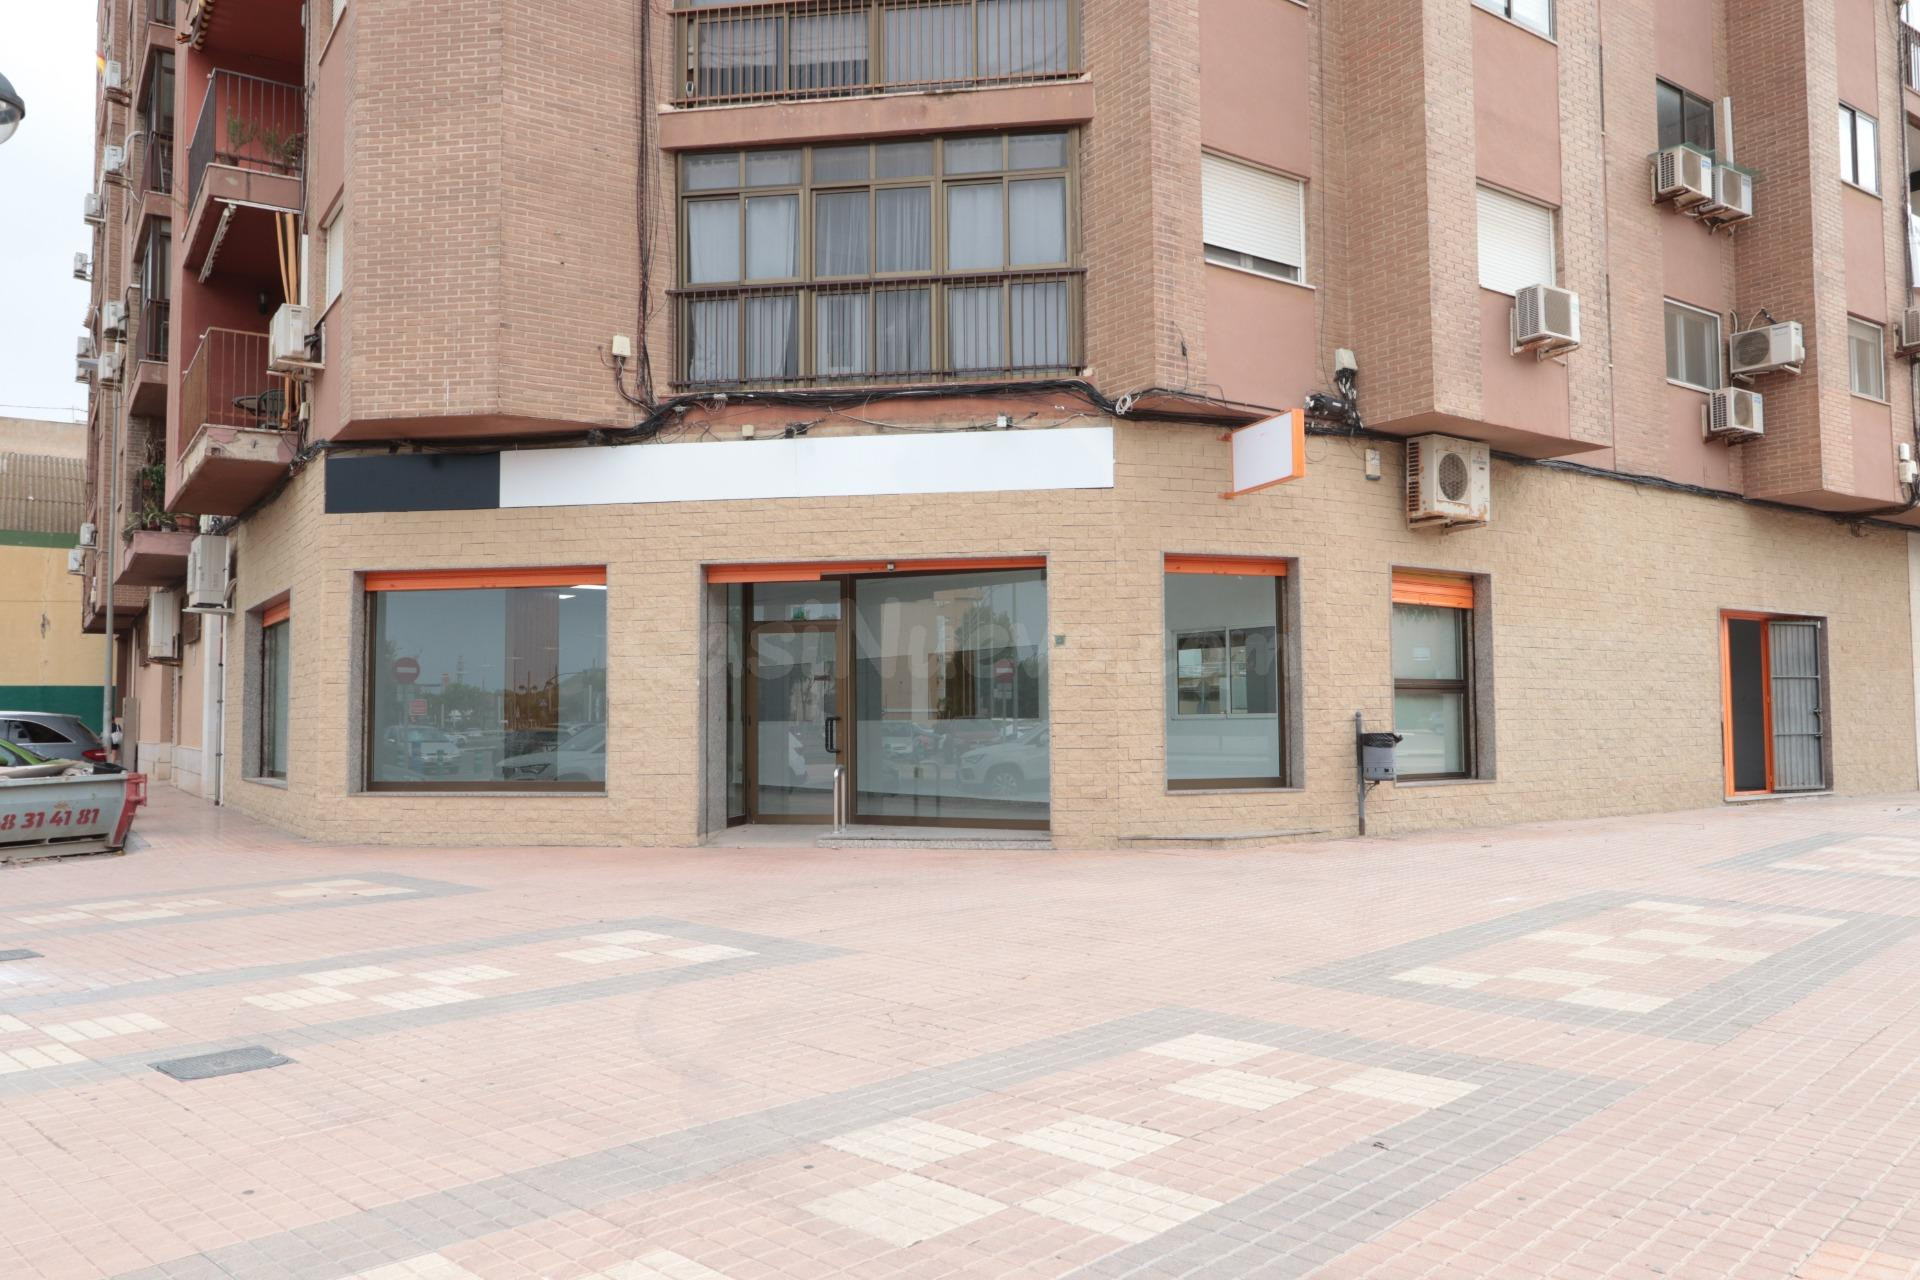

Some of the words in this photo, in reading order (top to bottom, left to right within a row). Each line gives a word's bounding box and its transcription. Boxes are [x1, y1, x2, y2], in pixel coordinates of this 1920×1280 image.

[20, 811, 46, 829] 31
[49, 810, 73, 826] 41
[76, 808, 100, 825] 81
